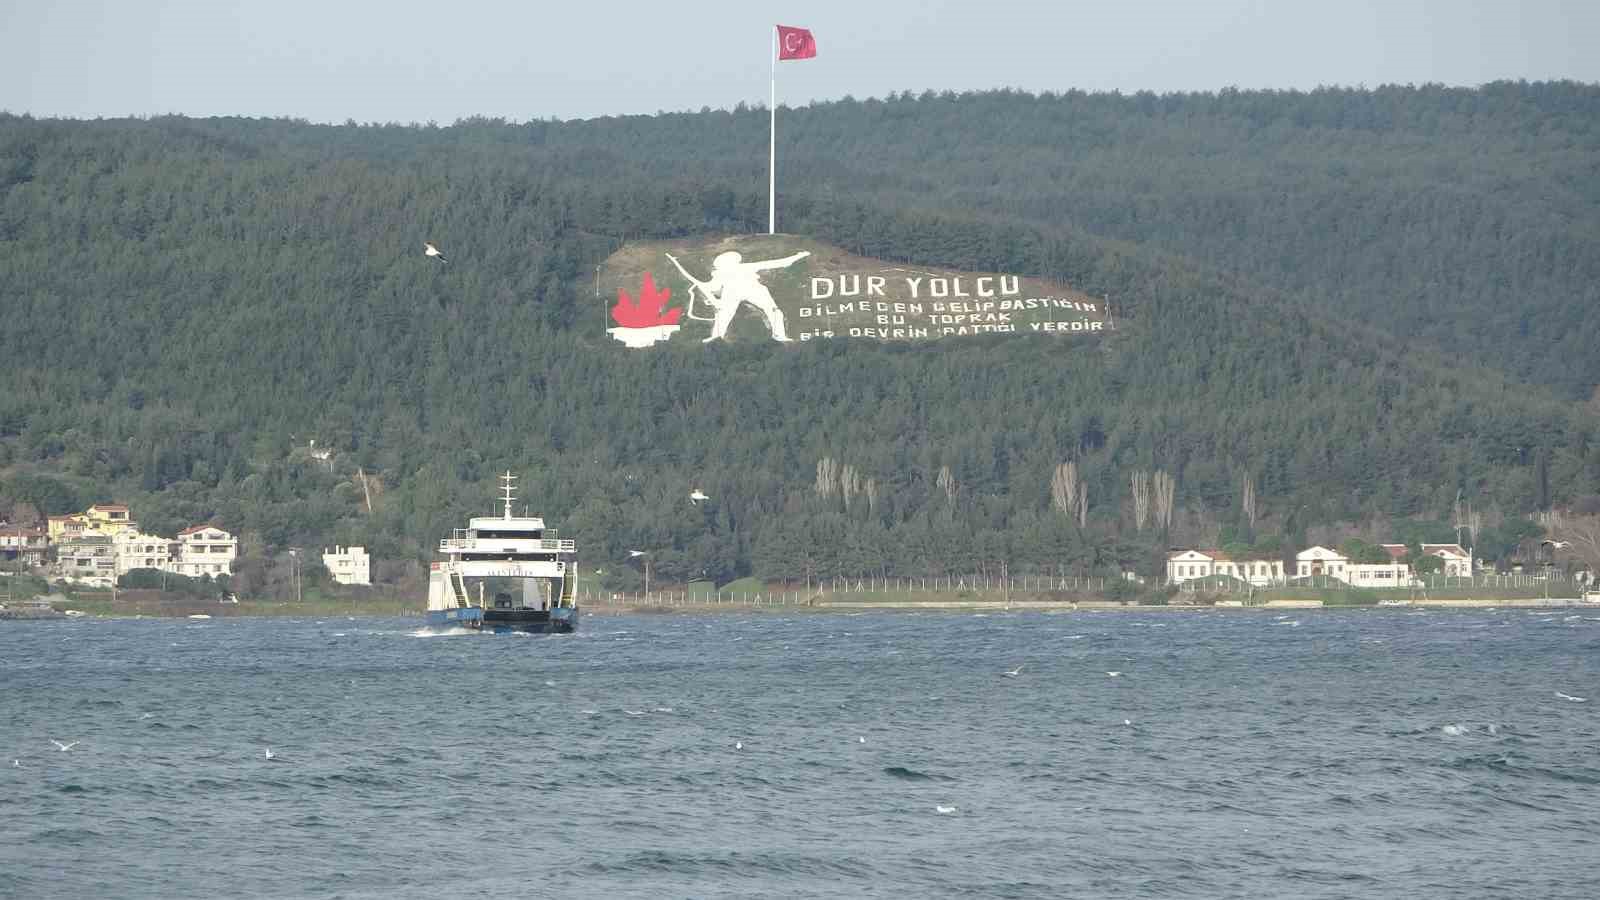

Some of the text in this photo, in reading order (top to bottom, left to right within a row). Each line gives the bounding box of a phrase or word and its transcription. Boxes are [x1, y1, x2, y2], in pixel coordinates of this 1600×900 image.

[811, 275, 1019, 299] DUR YOLCU
[877, 312, 1011, 325] BU TOPRAK
[1029, 318, 1104, 331] YERDİR
